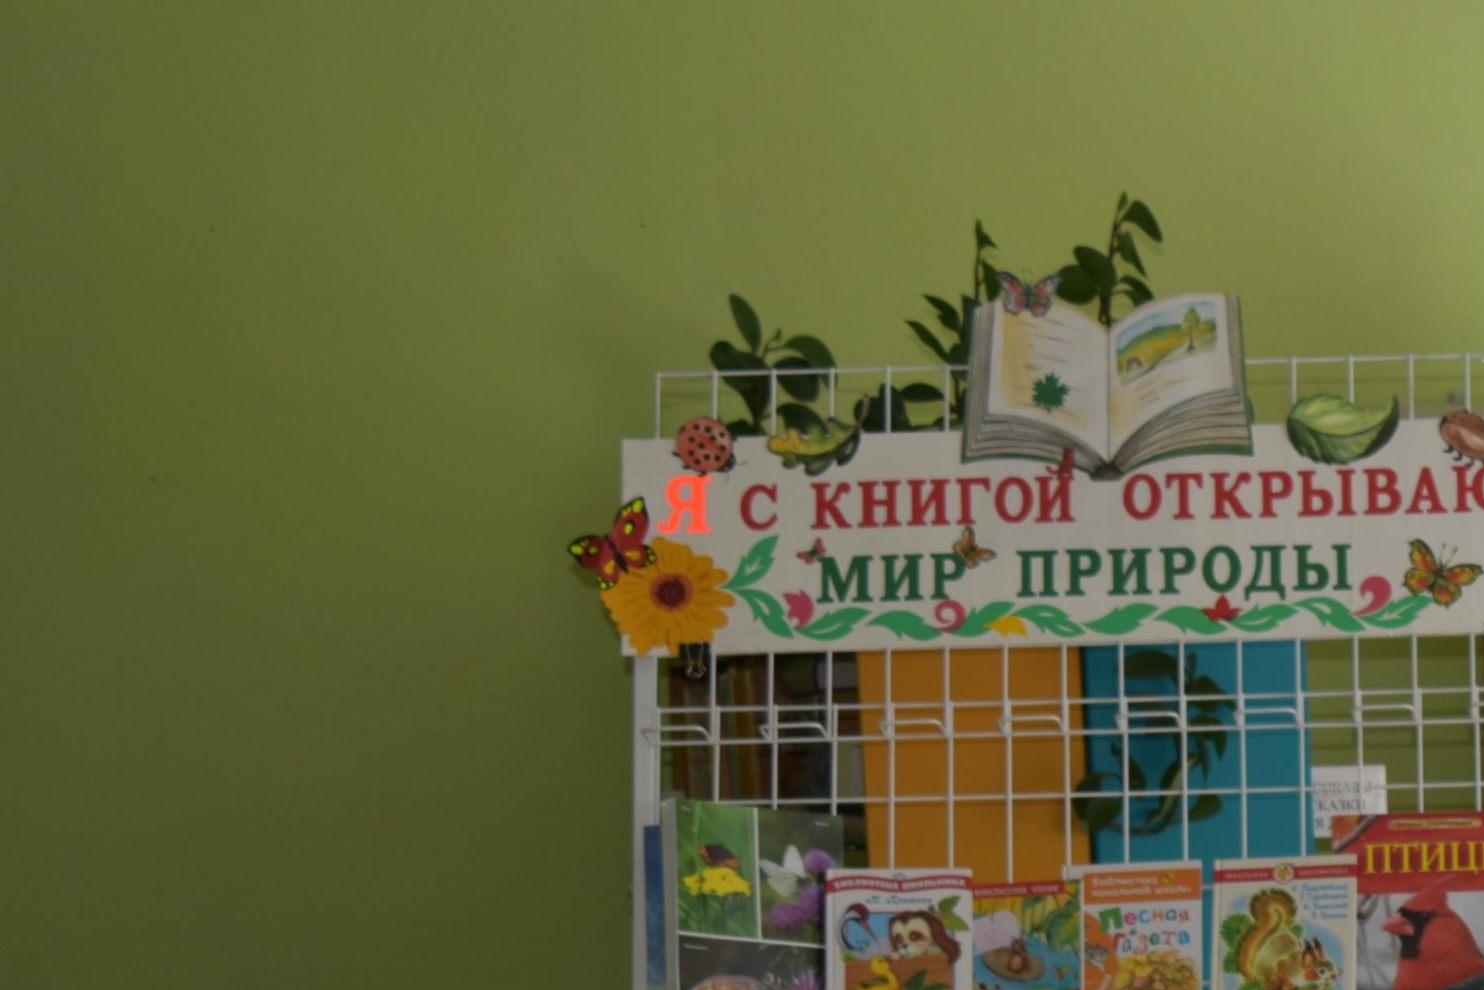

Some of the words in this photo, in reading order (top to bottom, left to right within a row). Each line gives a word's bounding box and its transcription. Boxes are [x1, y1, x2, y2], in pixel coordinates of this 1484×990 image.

[656, 475, 712, 534] Я
[740, 483, 778, 530] С
[809, 465, 1077, 531] КНИГОЙ
[816, 550, 967, 605] МИР
[1016, 542, 1352, 603] ПРИРОДЫ
[1099, 907, 1190, 933] Лесная
